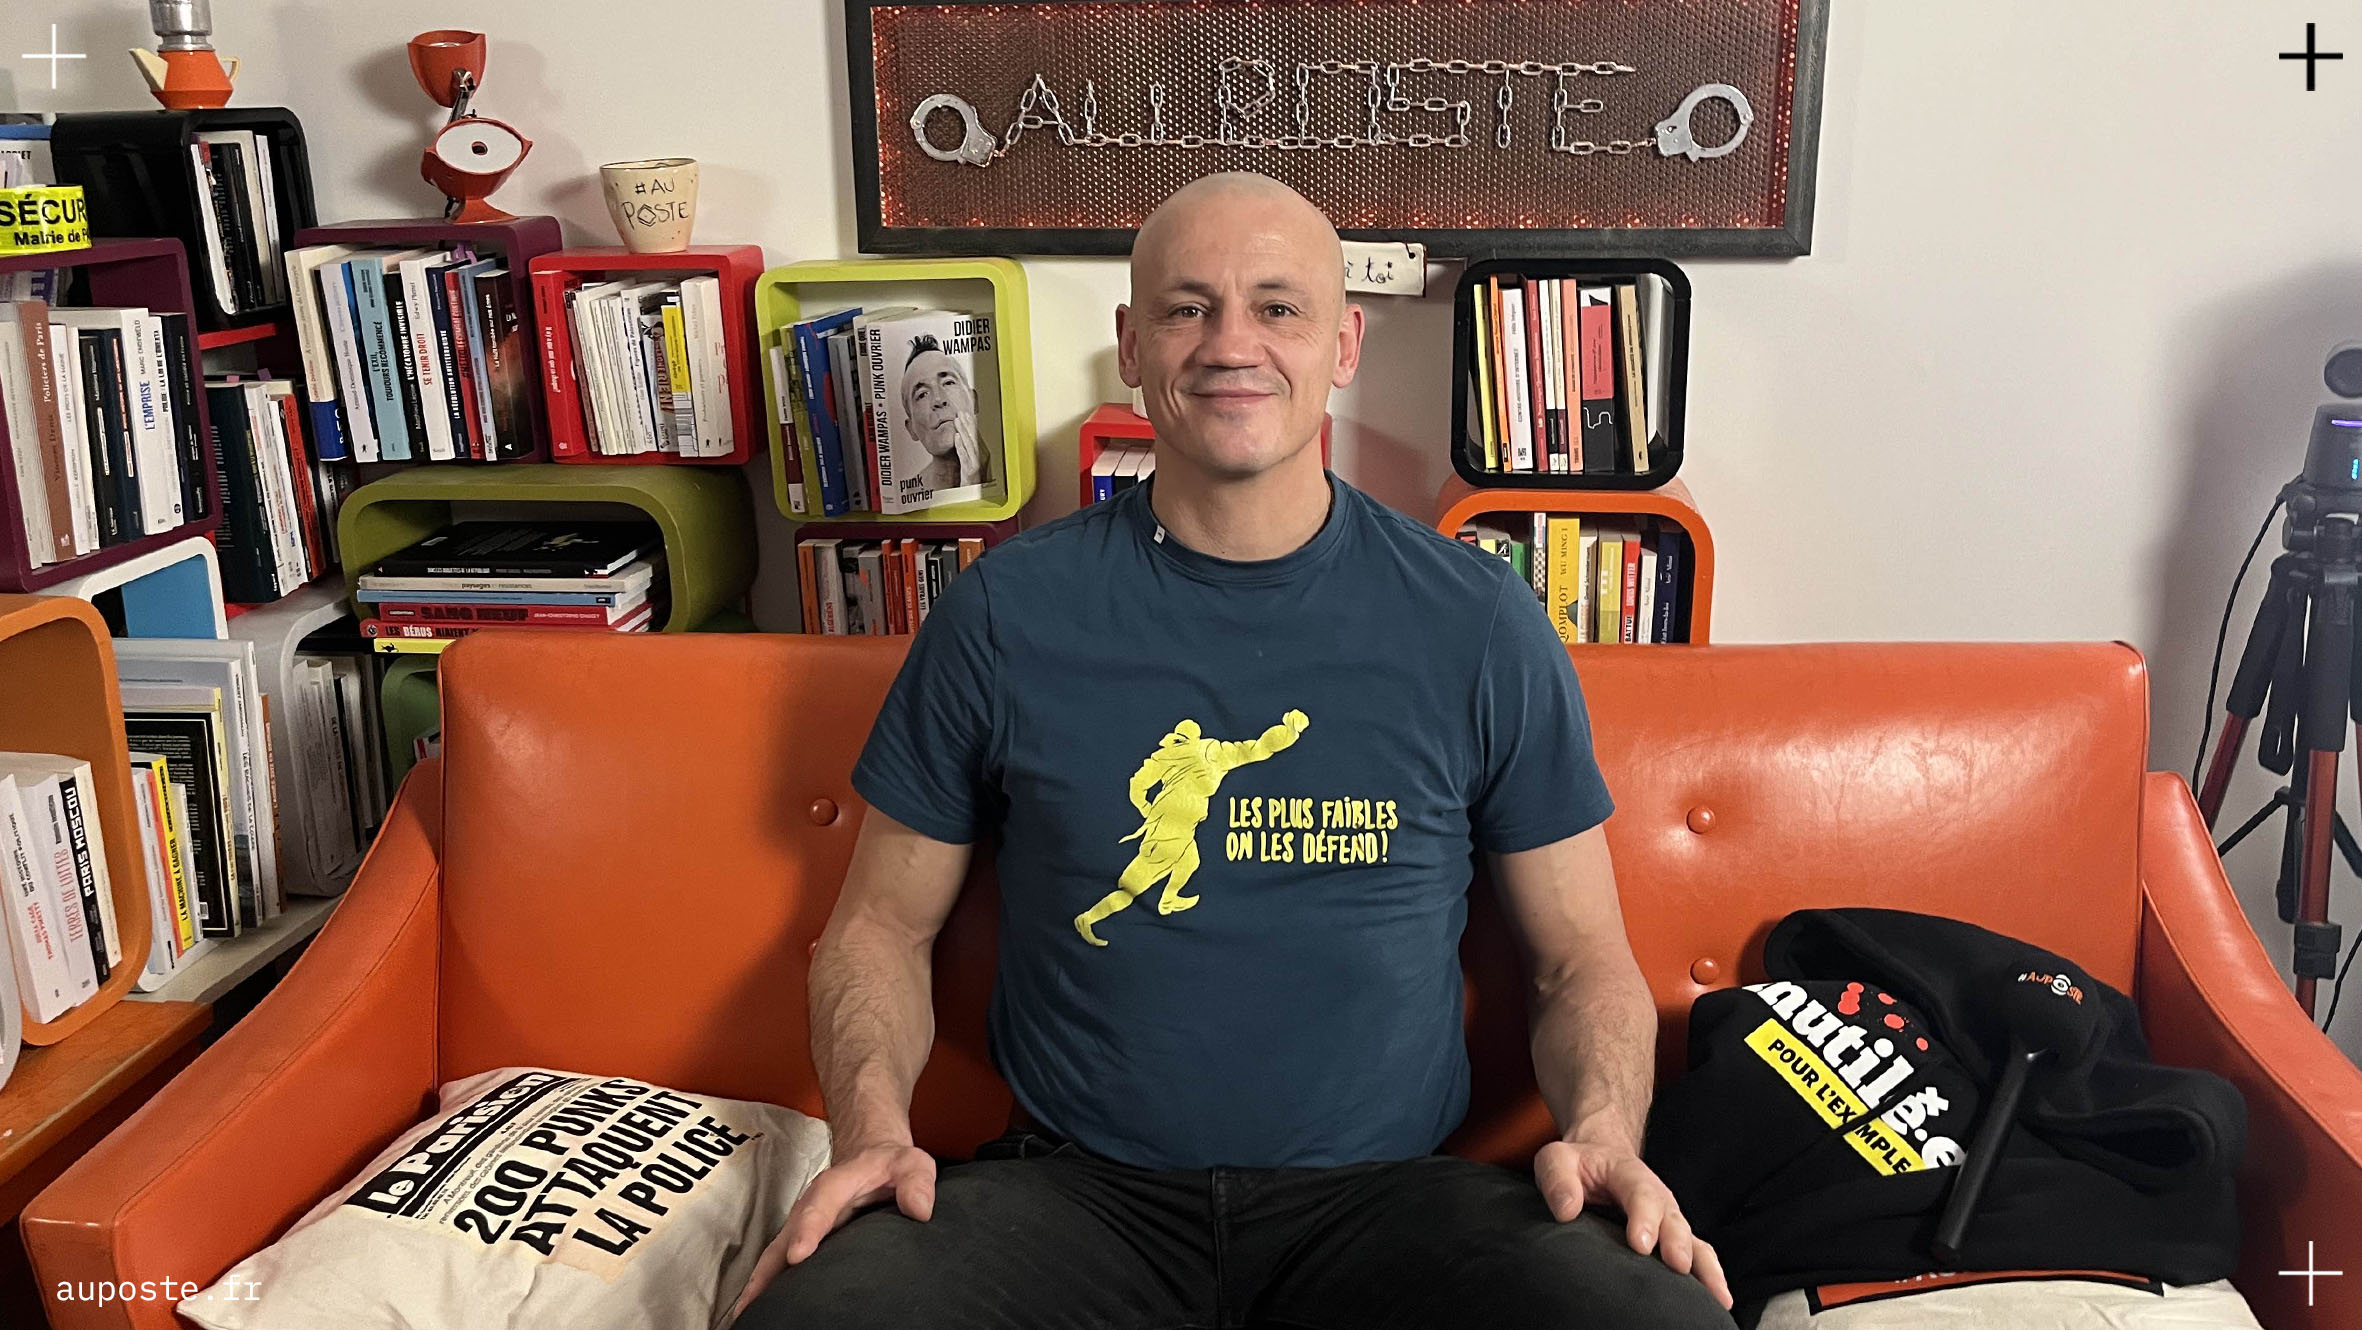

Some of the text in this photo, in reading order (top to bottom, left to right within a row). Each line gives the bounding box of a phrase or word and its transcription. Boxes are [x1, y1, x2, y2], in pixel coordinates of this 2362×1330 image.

[14, 228, 64, 246] Mairie
[68, 230, 80, 243] de
[394, 299, 415, 380] L'HÉCATOMBE INVISIBLE
[943, 337, 991, 355] WAMPAS
[954, 319, 990, 337] DIDIER
[33, 321, 51, 402] Policiers de Paris
[373, 319, 394, 401] TOUJOURS RECOMMENCÉ
[415, 332, 432, 386] SE TENIR DROIT
[868, 328, 883, 371] OUVRIER
[139, 380, 156, 430] L'EMPRISE
[871, 372, 885, 400] PUNK
[874, 410, 890, 453] WAMPAS
[878, 455, 893, 486] DIDIER
[900, 474, 924, 492] punk
[901, 488, 934, 504] ouvrier
[1560, 560, 1567, 574] WU
[386, 625, 400, 637] LES
[1229, 797, 1262, 829] LES
[1269, 797, 1313, 829] PLUS
[64, 786, 95, 897] PARIS MOSCOU
[168, 837, 180, 867] GAGNER
[1226, 831, 1253, 861] ON
[1260, 831, 1294, 862] LES
[53, 848, 73, 888] LUTTES
[63, 901, 83, 943] TERRES
[180, 910, 189, 921] LA
[388, 1074, 555, 1175] Parisien
[1767, 1038, 1912, 1174] POUR L'EXMPLE
[453, 1077, 651, 1245] 200 PUNKS
[508, 1090, 703, 1257] ATTAQUENT
[572, 1115, 752, 1256] LA POLICE
